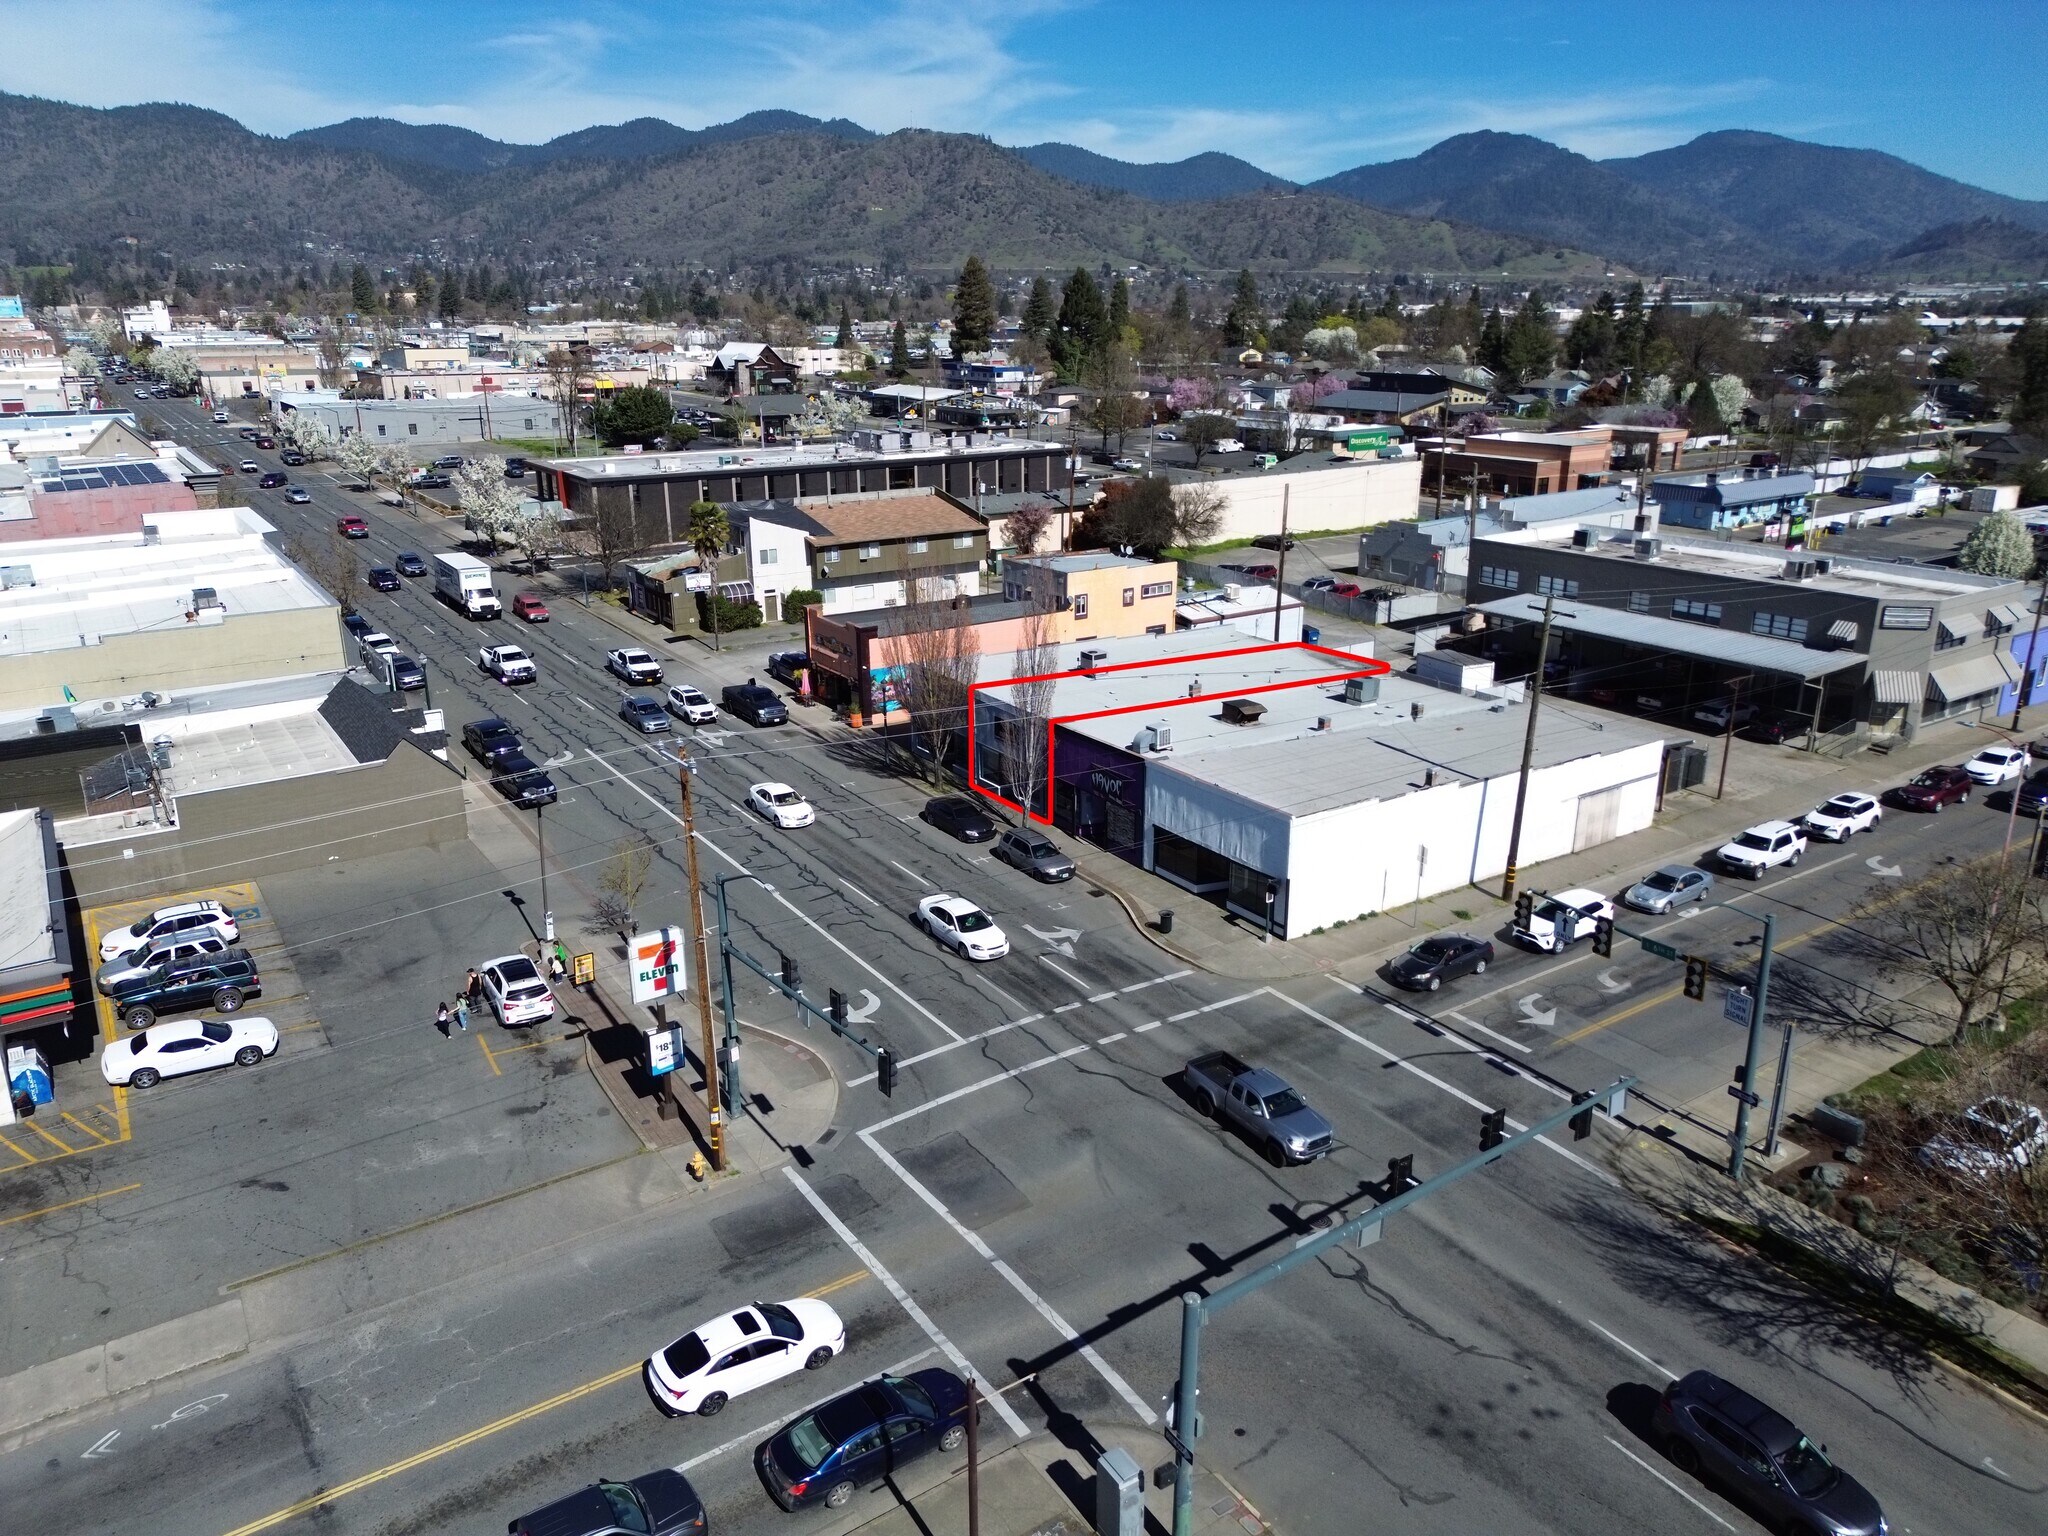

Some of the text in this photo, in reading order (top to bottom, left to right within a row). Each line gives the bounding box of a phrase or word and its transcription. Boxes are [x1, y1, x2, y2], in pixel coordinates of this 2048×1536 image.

[1350, 437, 1376, 445] Discovery
[1730, 993, 1748, 1006] RIGHT
[1730, 1001, 1746, 1014] TURN
[1725, 1009, 1748, 1025] SIGNAL
